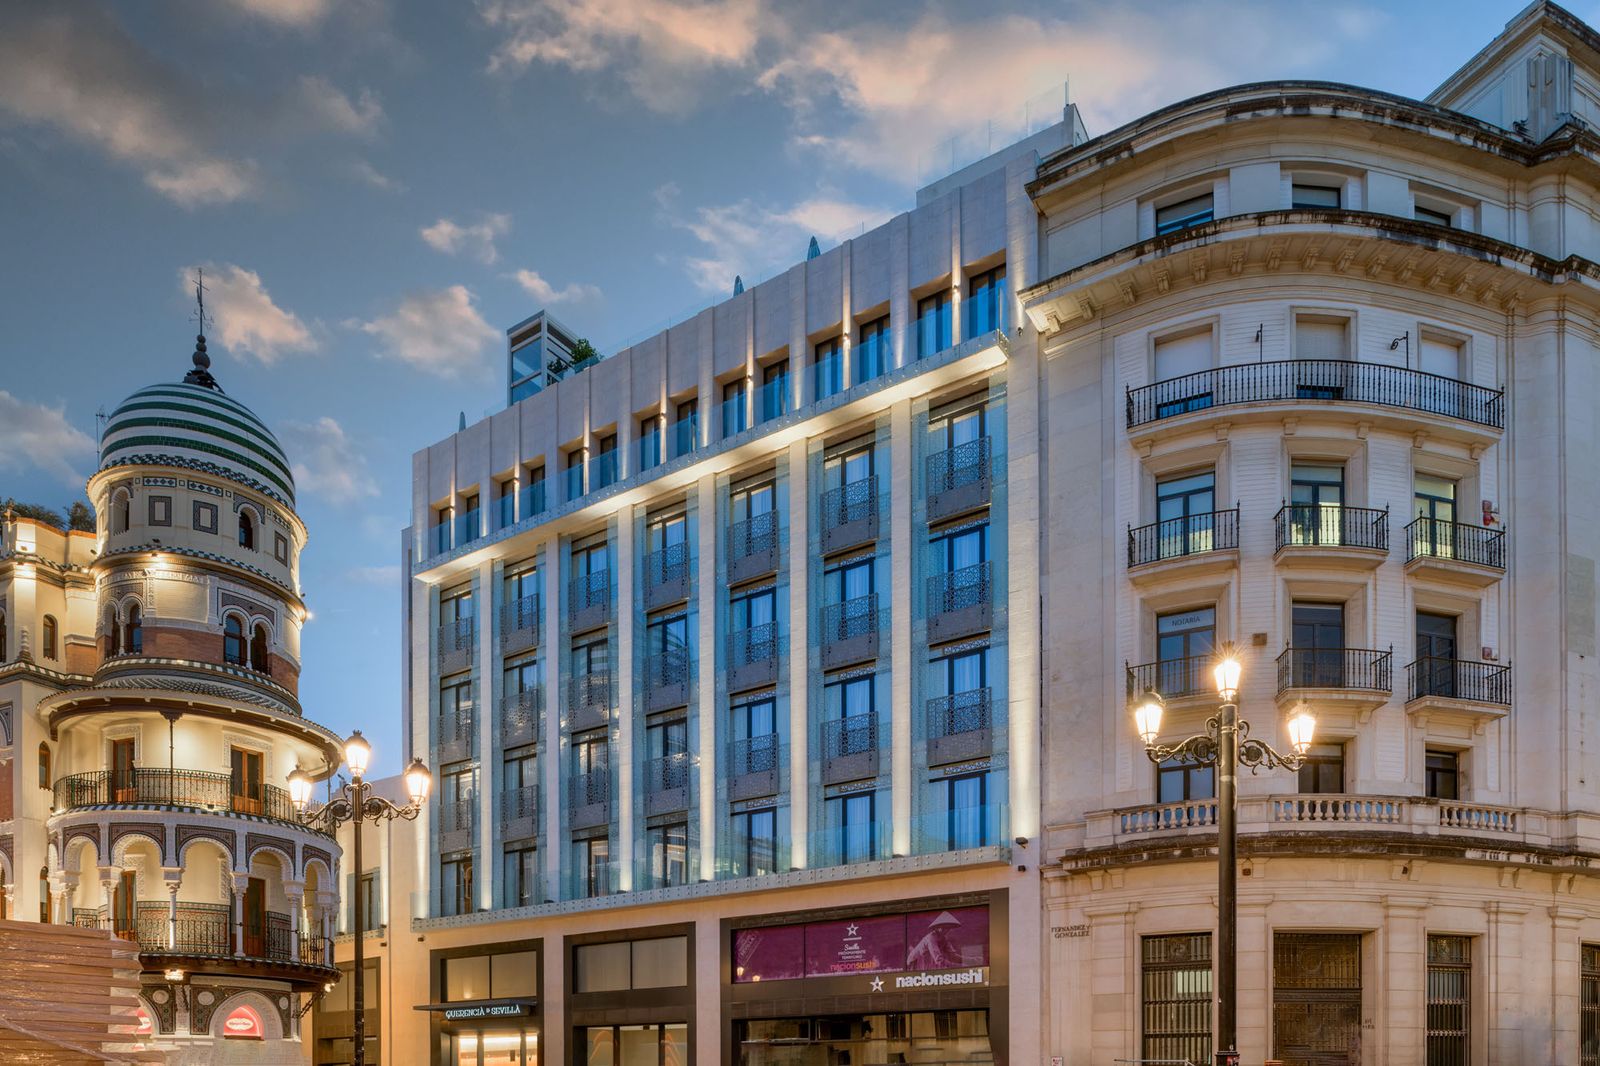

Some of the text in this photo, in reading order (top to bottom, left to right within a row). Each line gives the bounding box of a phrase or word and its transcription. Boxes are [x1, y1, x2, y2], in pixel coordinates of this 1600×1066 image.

[896, 968, 983, 988] nacionsushi
[445, 1006, 485, 1019] QUERENCIA
[491, 1004, 521, 1015] SEVILLA
